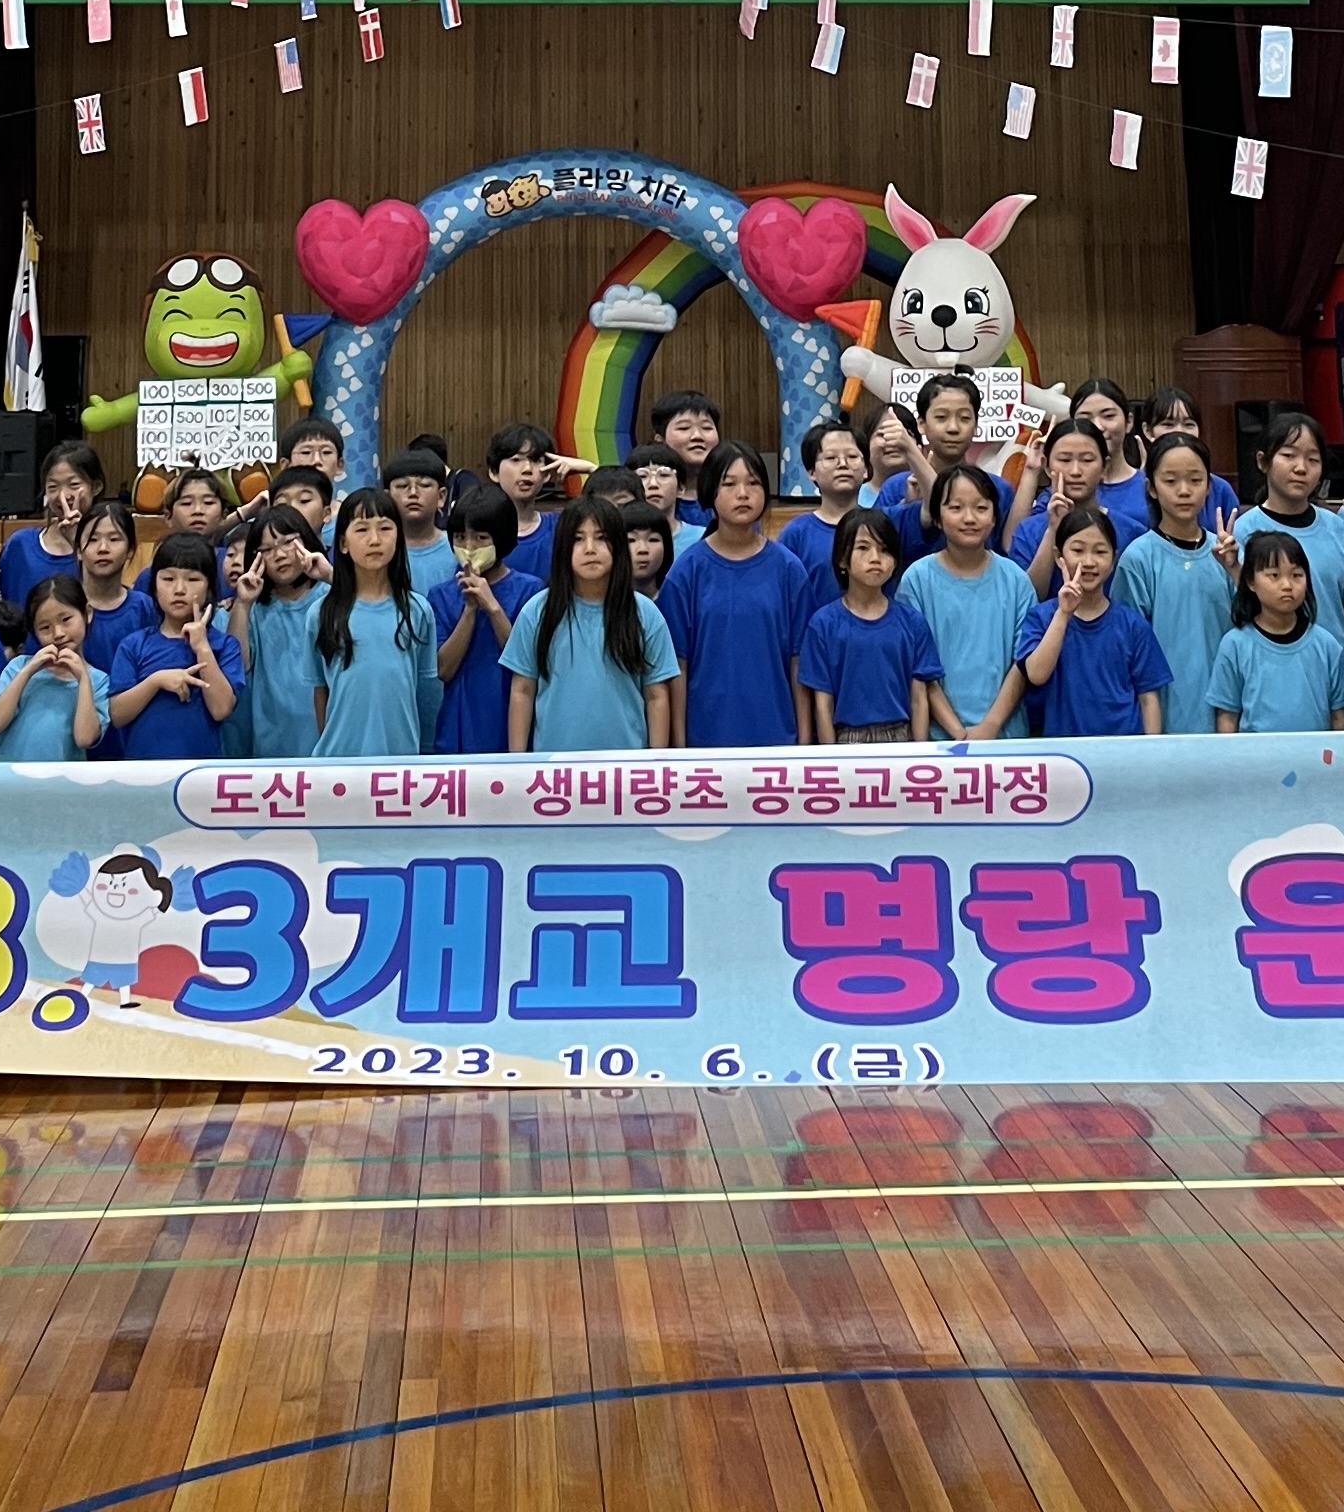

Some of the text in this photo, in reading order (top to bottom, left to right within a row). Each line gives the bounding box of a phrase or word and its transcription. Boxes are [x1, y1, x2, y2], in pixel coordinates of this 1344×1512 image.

[553, 167, 687, 210] 플라잉 치타
[896, 372, 921, 384] 100
[992, 371, 1018, 382] 500
[143, 382, 273, 399] 100 500 300 500
[992, 389, 1018, 400] 500
[141, 409, 270, 424] 100 500 100 500
[978, 405, 1004, 418] 300
[1013, 408, 1041, 424] 300
[141, 431, 168, 445] 100
[175, 431, 202, 444] 500
[990, 425, 1016, 438] 100
[247, 445, 273, 459] 100
[210, 770, 312, 819] 도산
[369, 768, 468, 818] 단계
[525, 766, 729, 817] 생비량초
[746, 762, 1049, 816] 공동교육과정
[175, 855, 698, 1024] 3개교
[771, 854, 1162, 1026] 명랑
[311, 1046, 942, 1082] 2023. 10. 6. (금)
